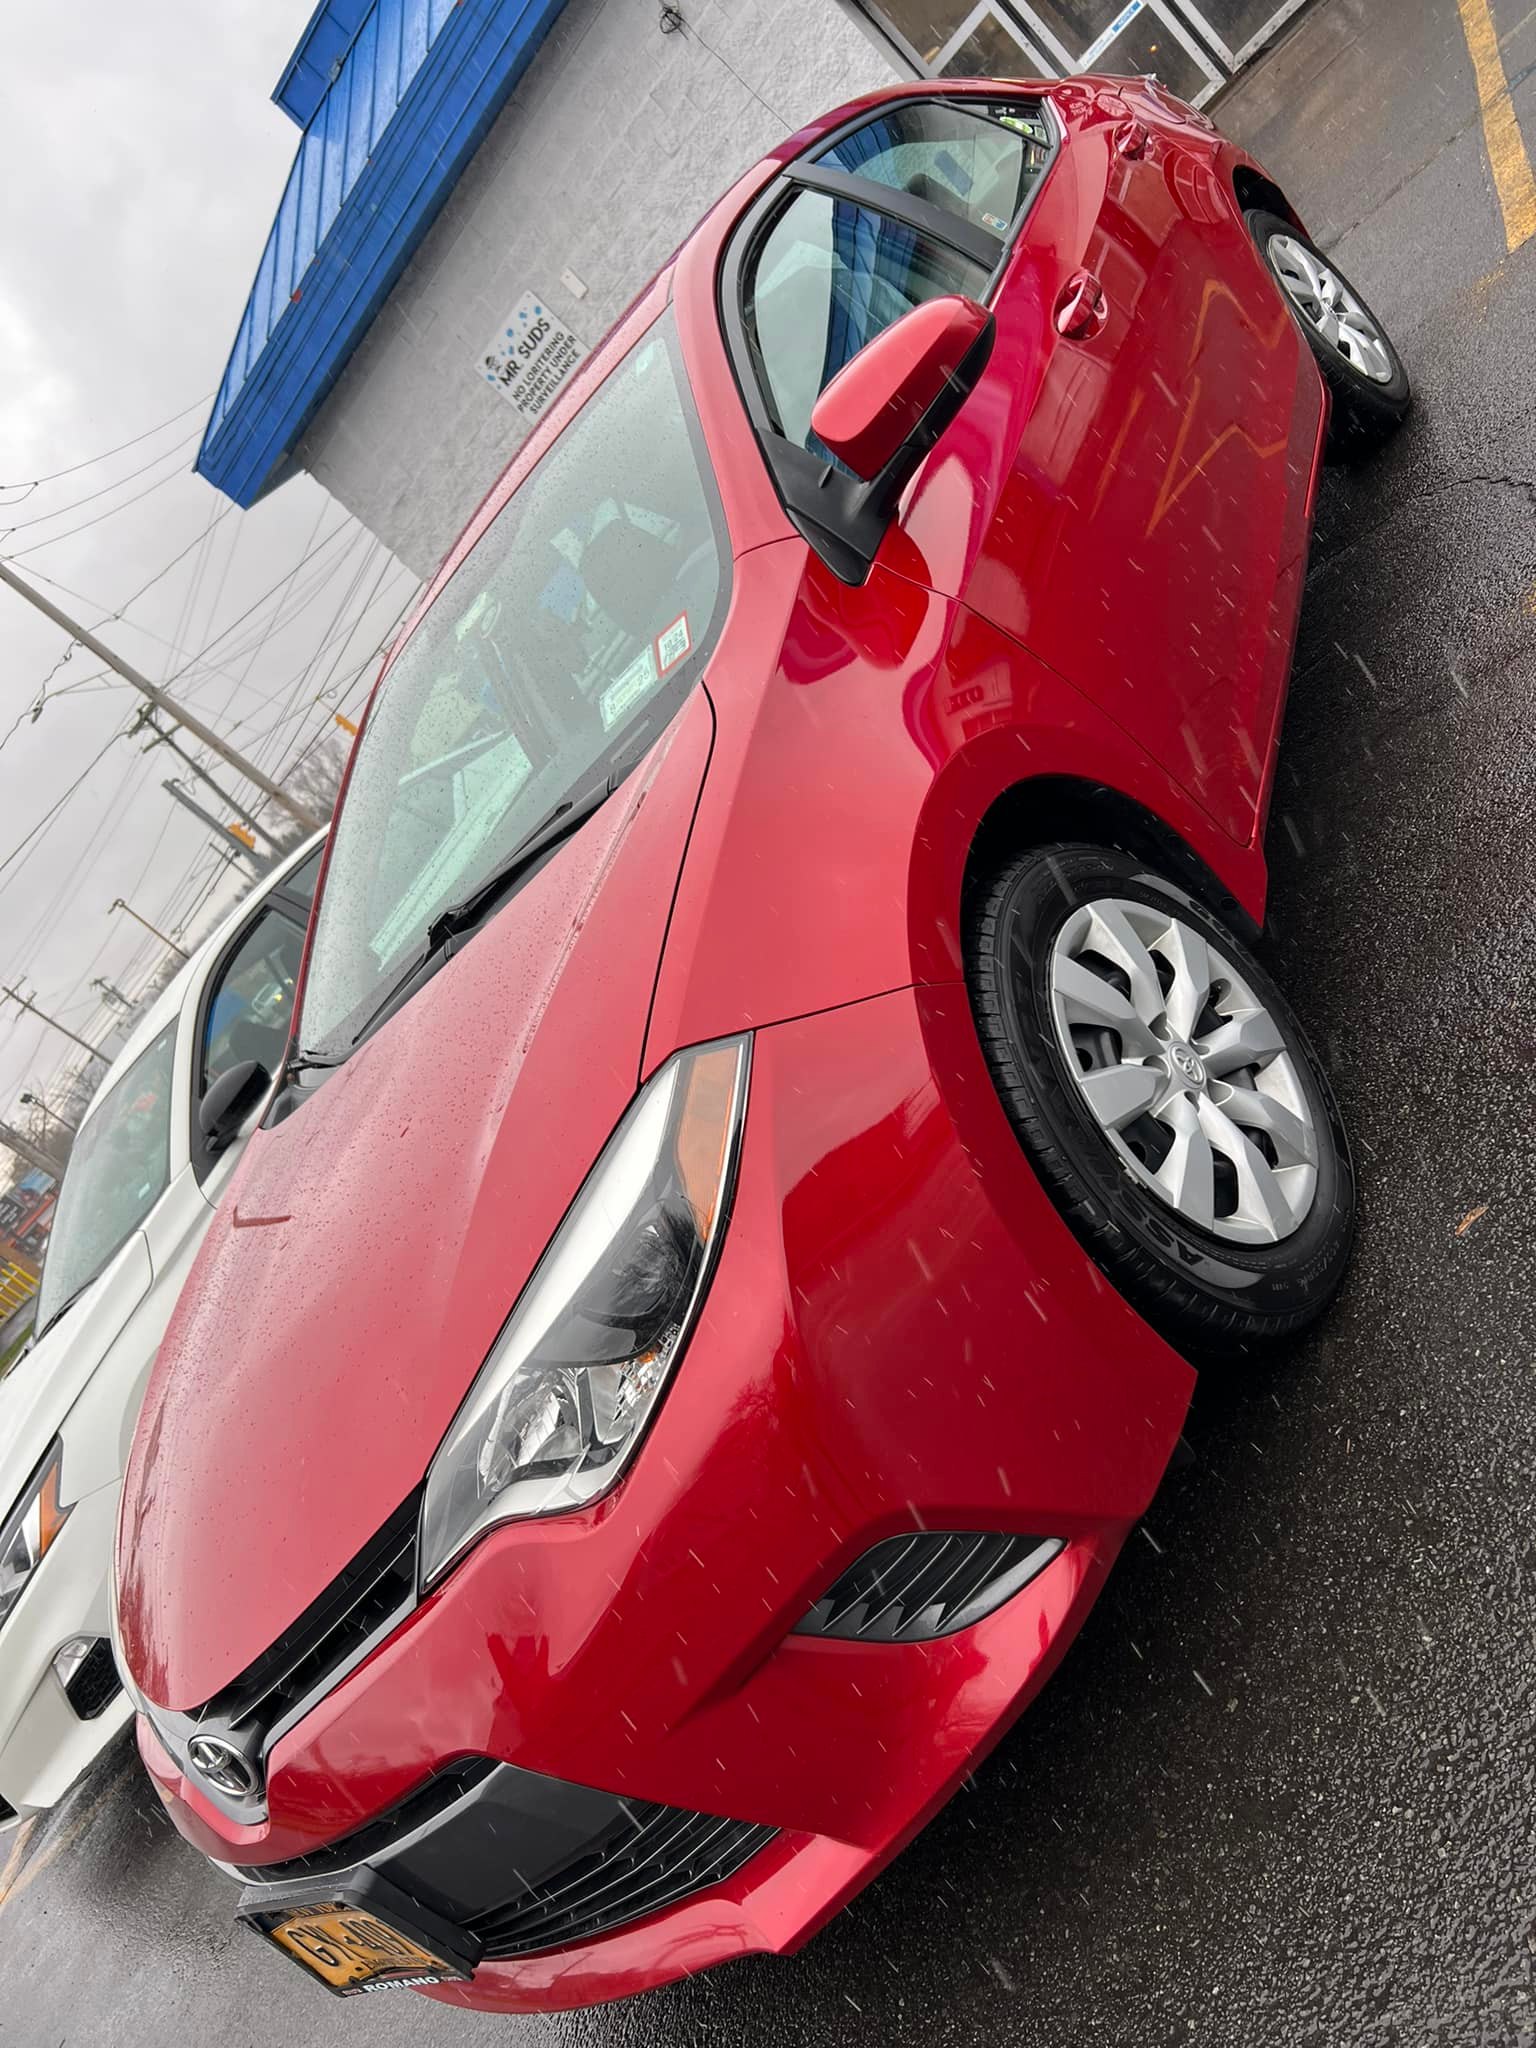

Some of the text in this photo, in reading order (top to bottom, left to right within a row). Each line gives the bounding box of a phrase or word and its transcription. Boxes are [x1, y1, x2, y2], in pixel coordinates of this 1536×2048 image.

[518, 317, 551, 359] SUDS
[512, 384, 526, 401] NO
[517, 335, 577, 413] PROPERTY UNDER
[529, 349, 581, 414] SURVEILLANCE
[362, 1976, 440, 1993] ROMANO
